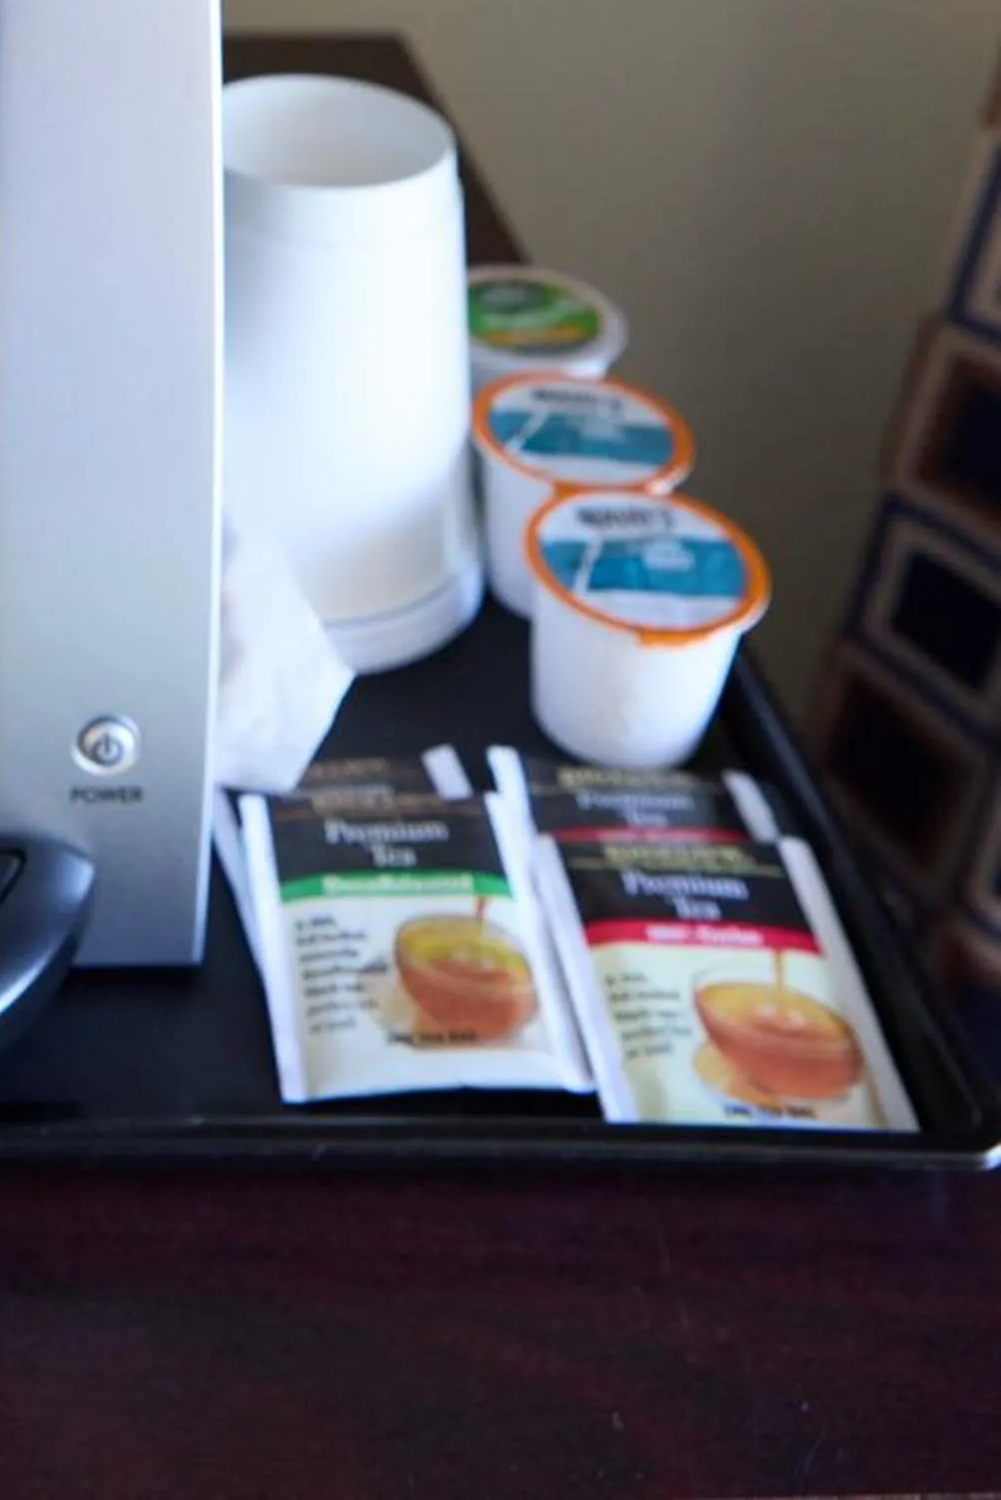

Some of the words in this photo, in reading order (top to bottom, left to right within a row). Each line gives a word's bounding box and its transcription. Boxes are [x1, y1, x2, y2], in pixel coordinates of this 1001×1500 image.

[323, 816, 451, 846] Premium
[369, 844, 418, 868] Tea
[619, 866, 750, 901] Premium
